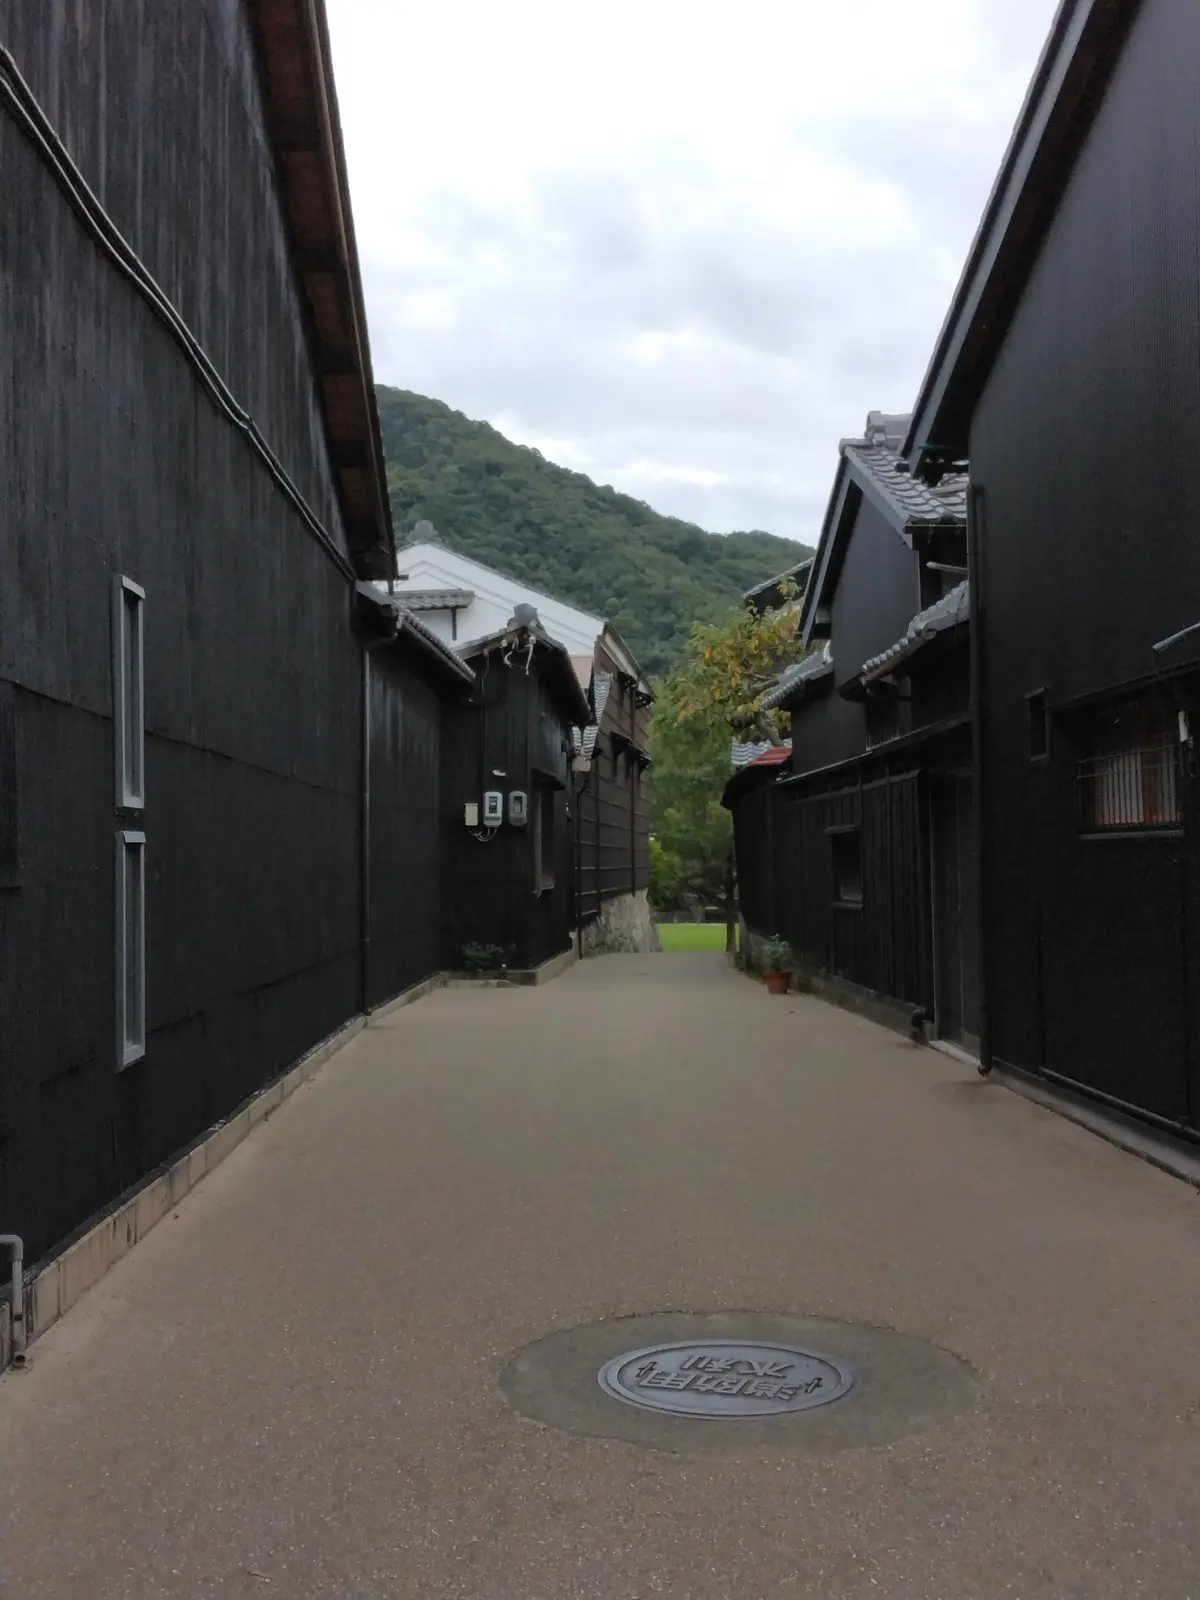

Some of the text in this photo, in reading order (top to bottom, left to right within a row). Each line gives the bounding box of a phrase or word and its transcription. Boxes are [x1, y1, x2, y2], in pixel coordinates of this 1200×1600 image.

[680, 1355, 794, 1379] 水利
[639, 1370, 800, 1401] 消防用
